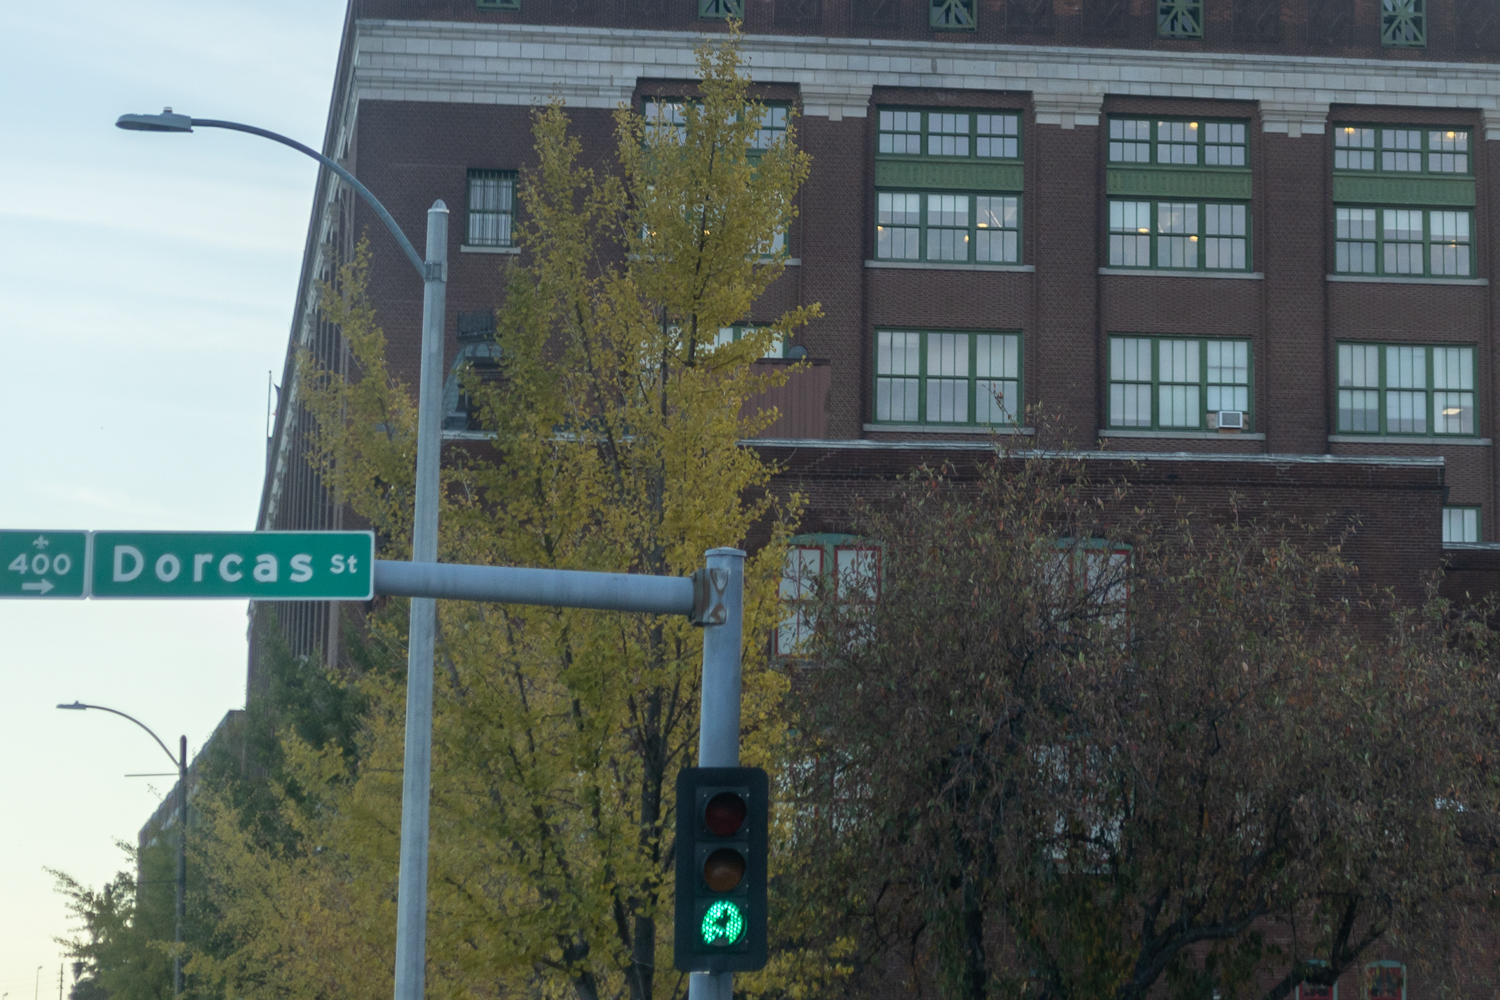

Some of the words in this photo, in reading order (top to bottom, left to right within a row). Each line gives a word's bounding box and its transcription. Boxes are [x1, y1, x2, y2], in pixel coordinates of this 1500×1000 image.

[8, 553, 71, 575] 400
[112, 545, 314, 583] Dorcas
[329, 554, 358, 574] St
